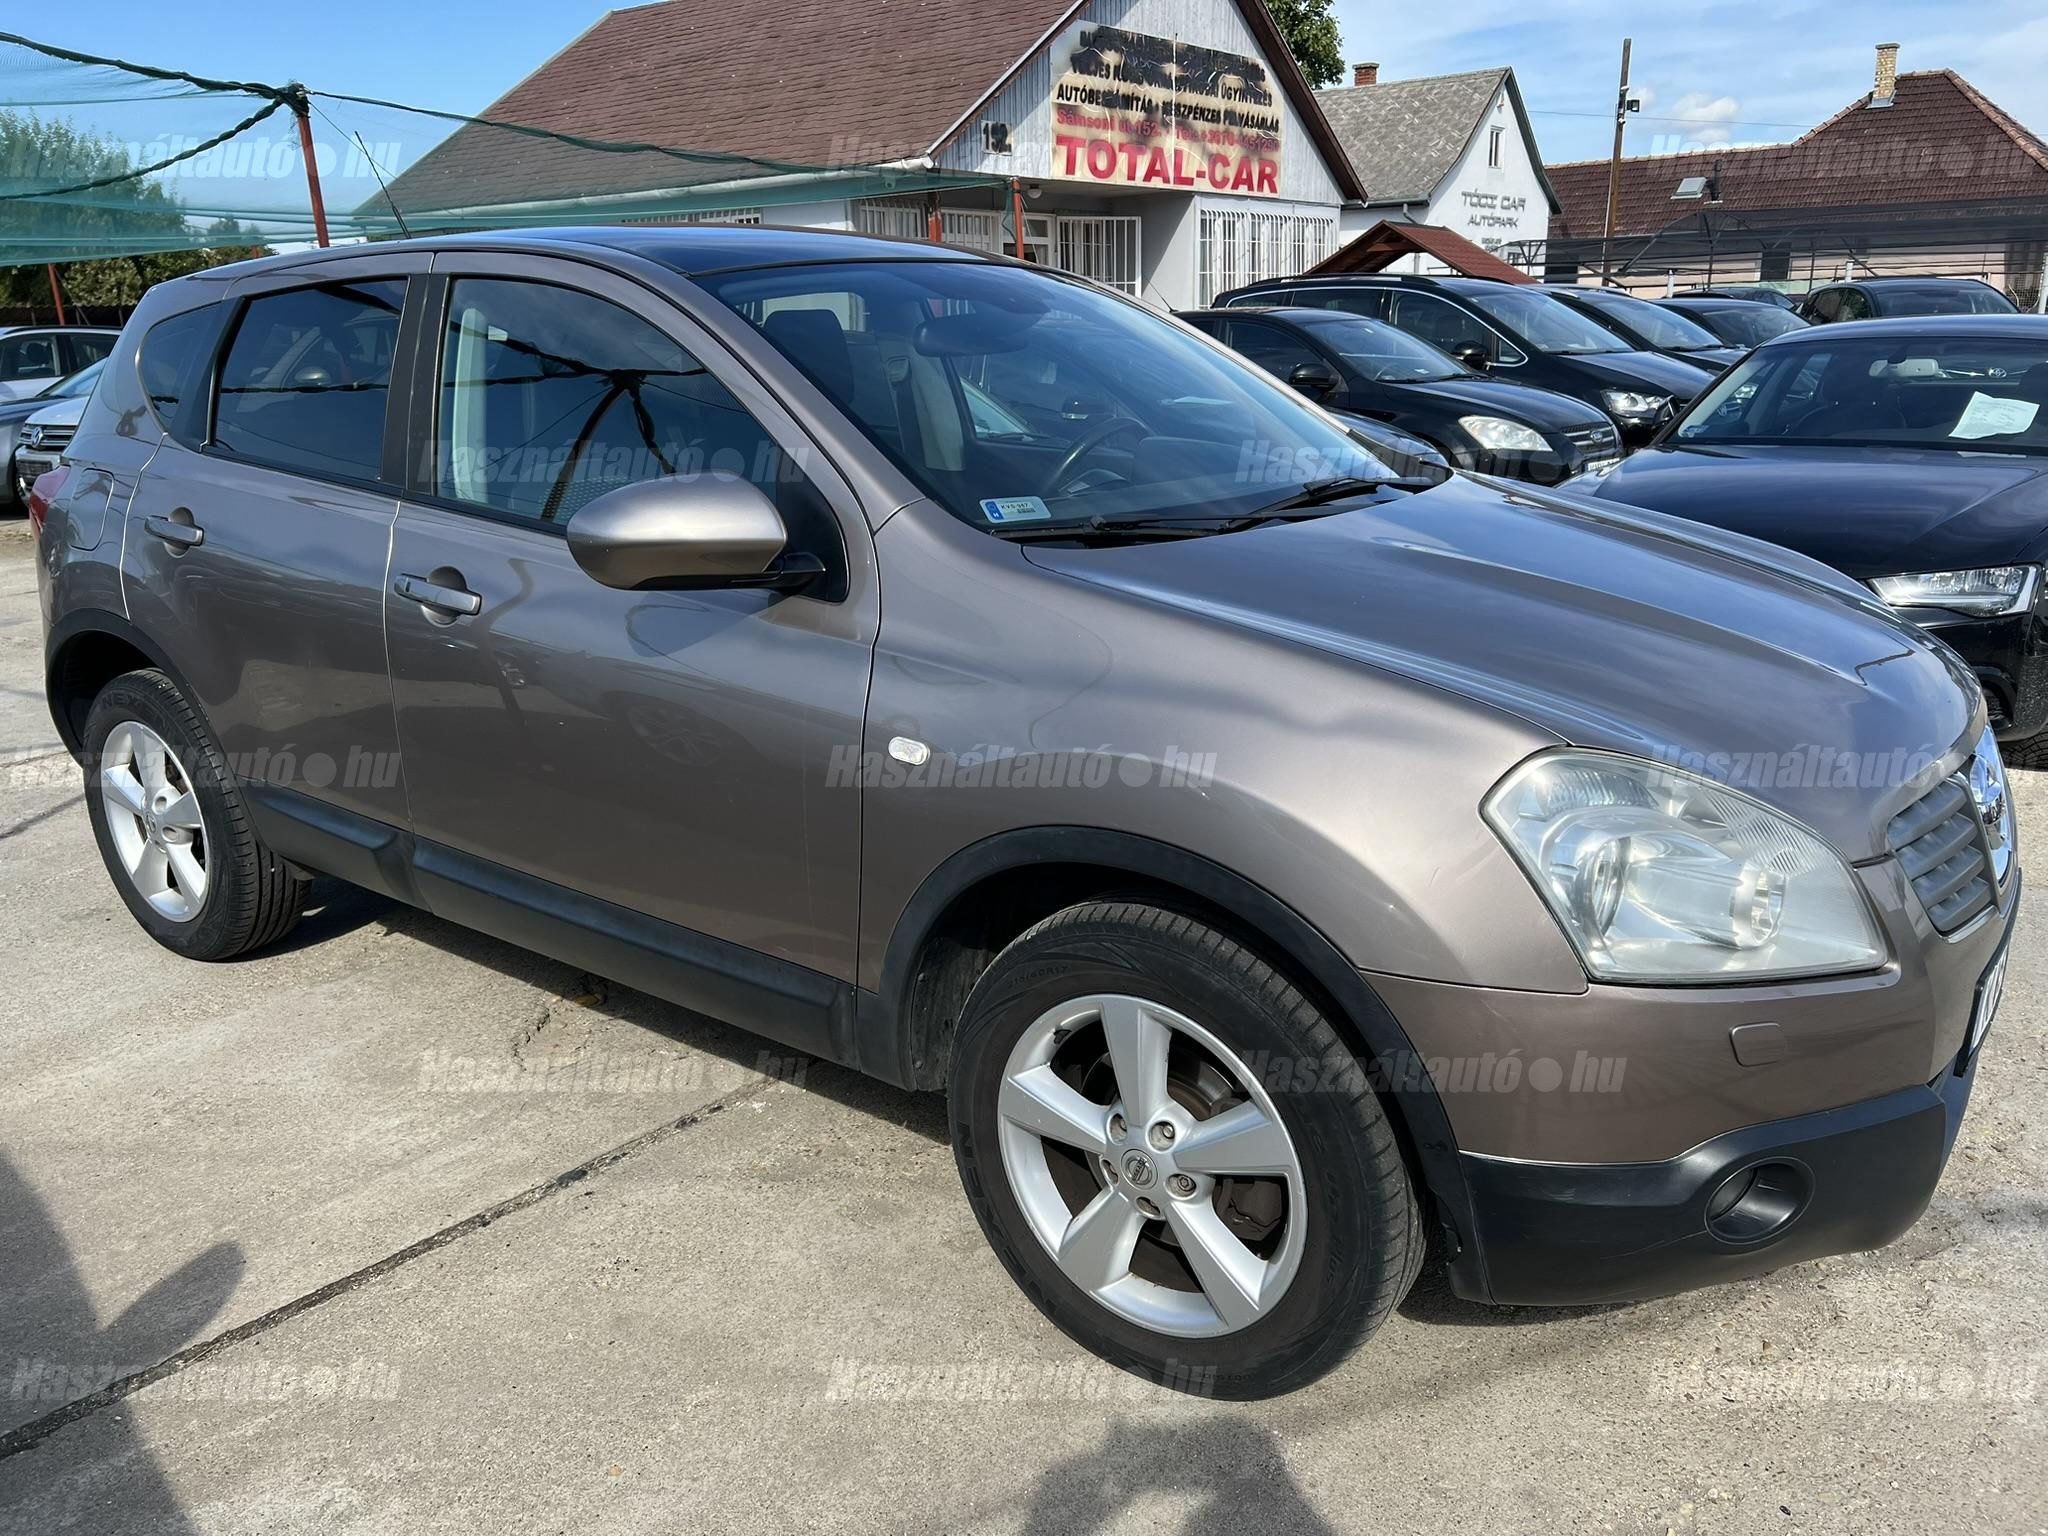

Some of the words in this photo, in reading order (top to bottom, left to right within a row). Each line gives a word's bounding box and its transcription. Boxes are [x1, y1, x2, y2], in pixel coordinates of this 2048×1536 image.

[1056, 135, 1279, 194] TOTAL-CAR
[1501, 195, 1526, 212] CAR
[1467, 212, 1519, 229] AUTÓPARK
